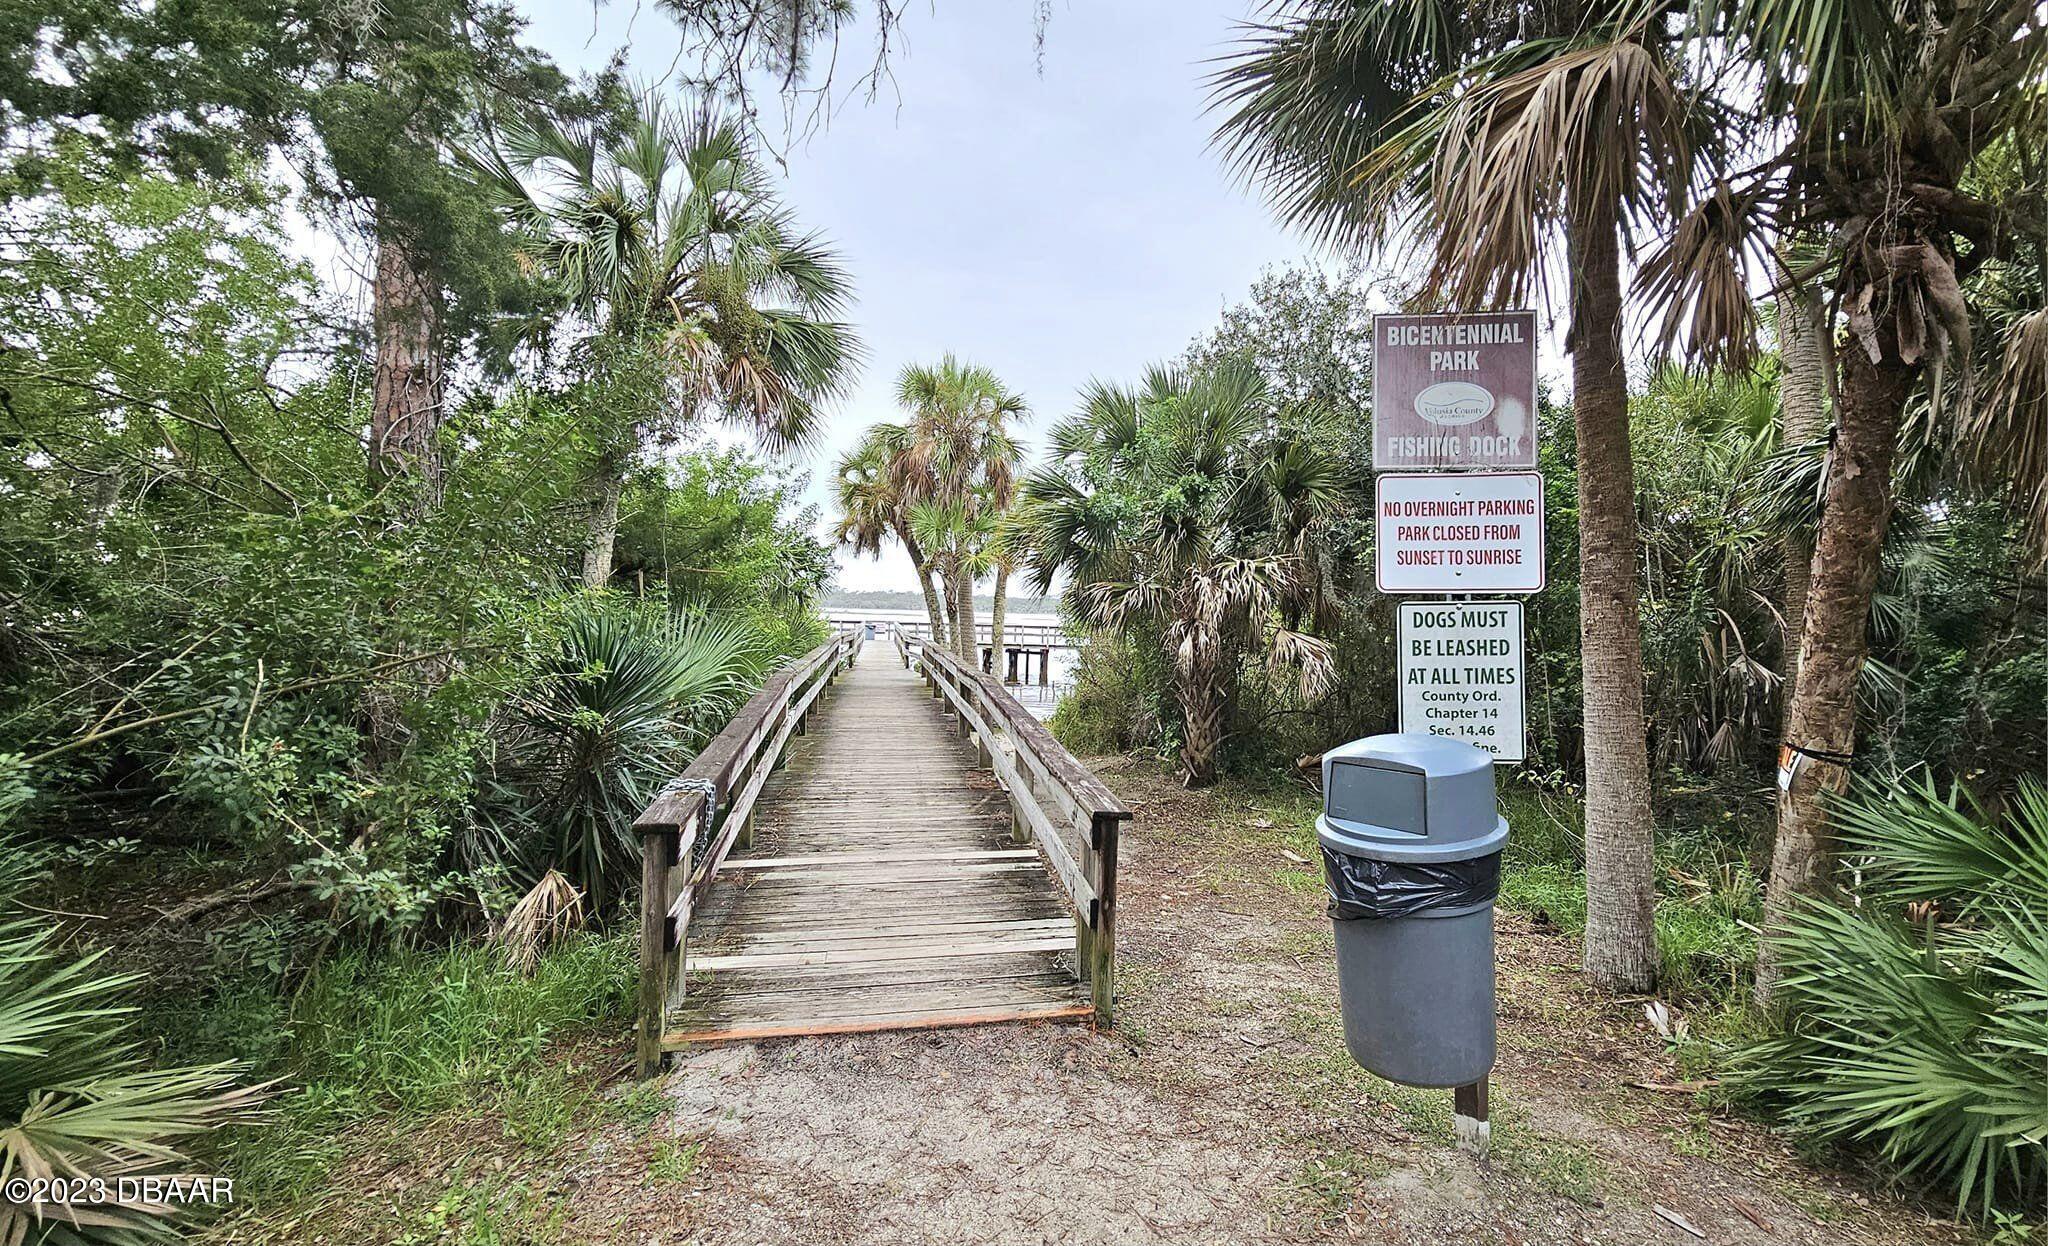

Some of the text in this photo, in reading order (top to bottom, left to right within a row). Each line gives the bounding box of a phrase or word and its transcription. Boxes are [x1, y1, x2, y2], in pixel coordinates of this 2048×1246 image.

[1387, 323, 1524, 346] BICENTENNIAL
[1430, 351, 1479, 371] PARK
[1454, 407, 1484, 415] County
[1388, 436, 1521, 457] FISHING DOCK
[1384, 499, 1534, 517] NO OVERNIGHT PARKING
[1398, 525, 1520, 541] PARK CLOSED FROM
[1397, 549, 1522, 565] SUNSET TO SUNRISE
[1413, 611, 1508, 628] DOGS MUST
[1412, 639, 1510, 656] BE LEASHED
[1408, 668, 1515, 685] AT ALL TIMES
[1422, 690, 1501, 704] County Ord.
[1425, 707, 1498, 721] Chapter 14
[1429, 724, 1495, 736] Sec. 14.46
